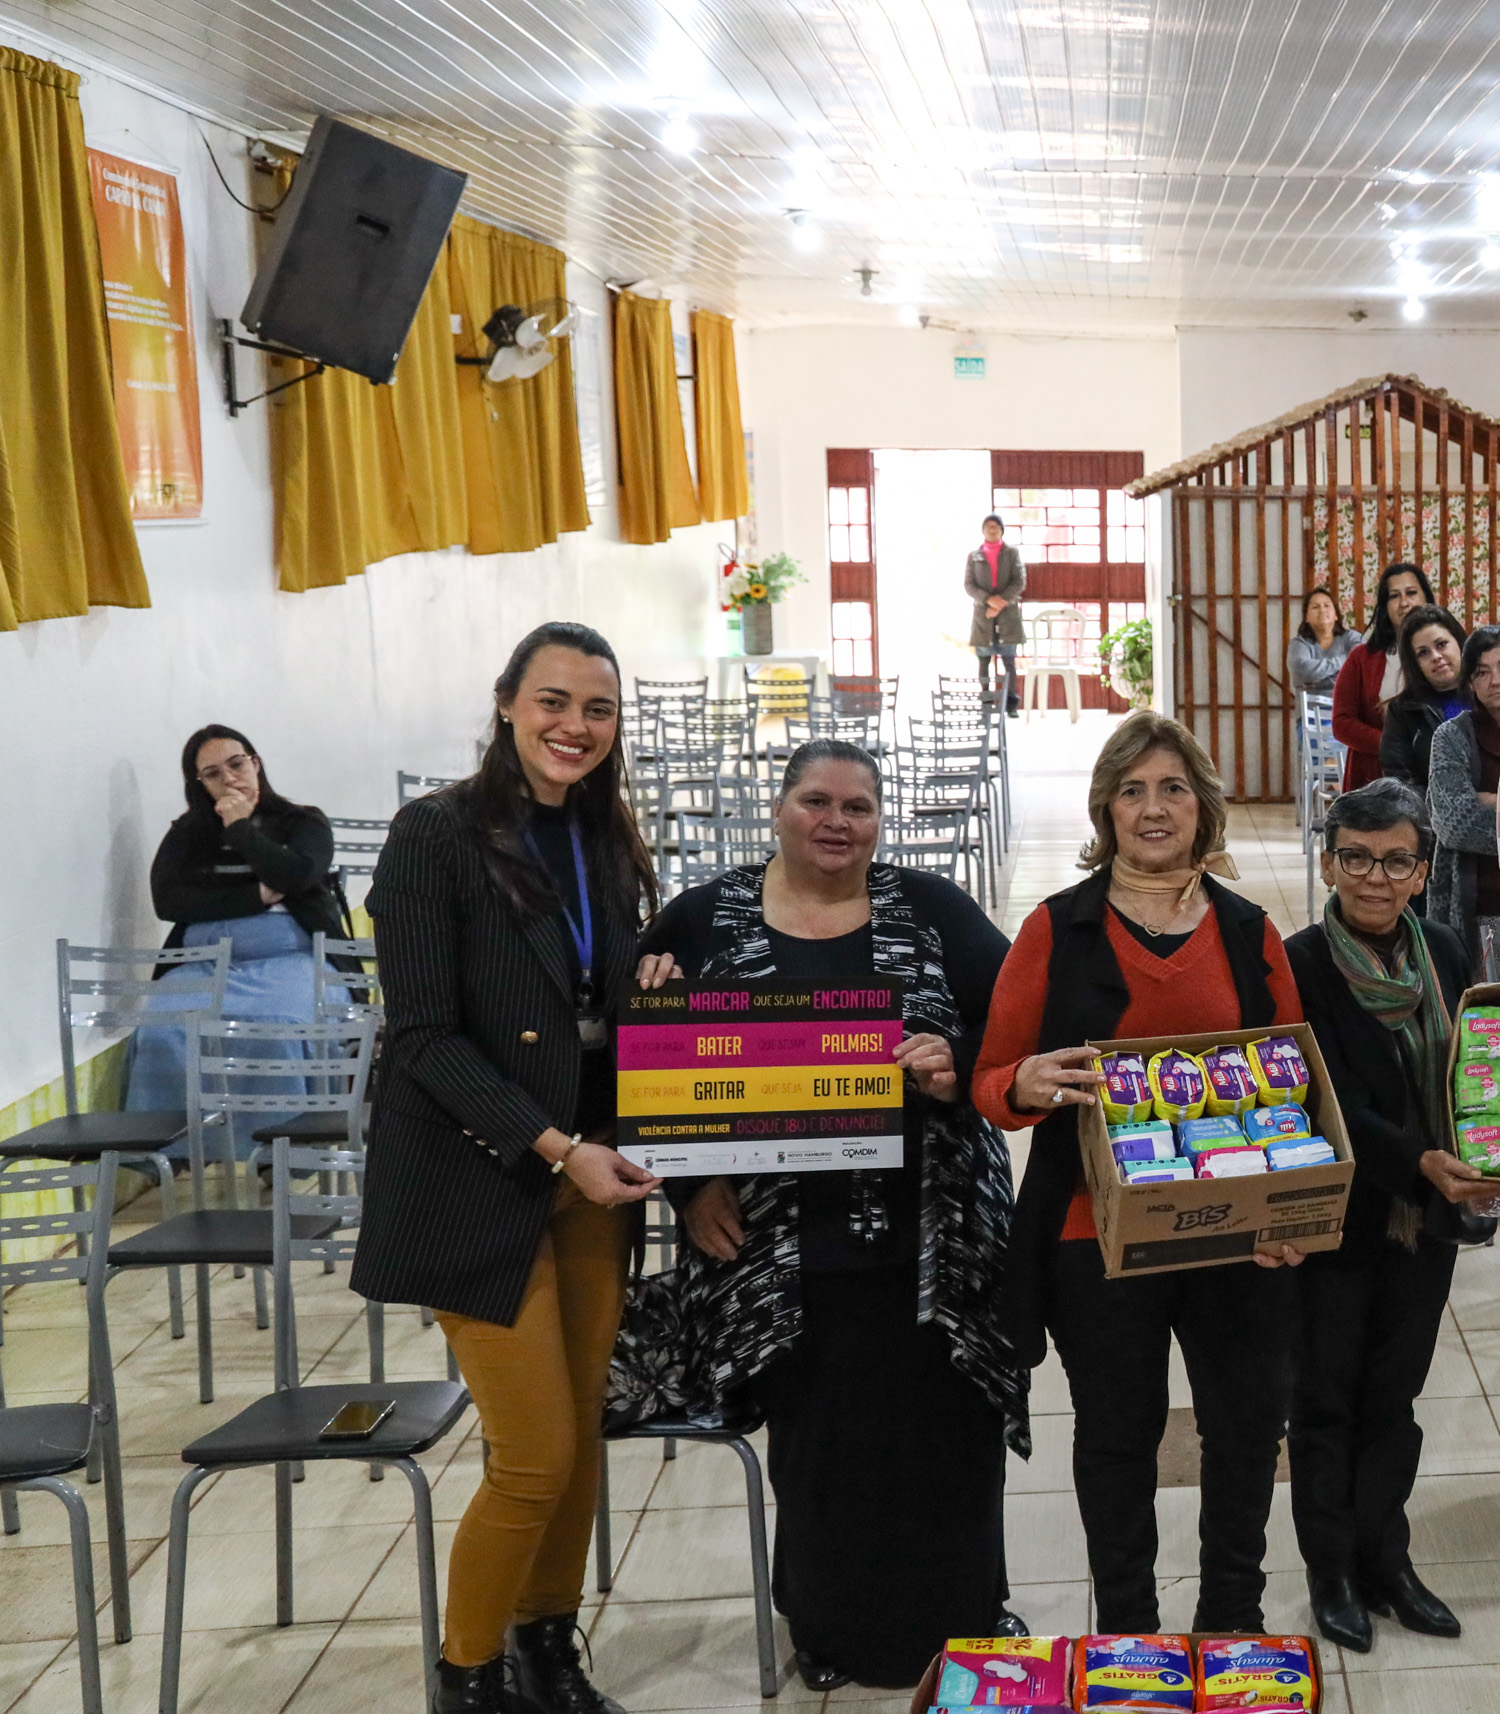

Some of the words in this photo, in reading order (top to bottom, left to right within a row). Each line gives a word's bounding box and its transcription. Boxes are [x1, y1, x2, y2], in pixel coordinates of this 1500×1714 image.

[630, 996, 641, 1009] SE
[643, 996, 661, 1009] FOR
[662, 996, 686, 1008] PARA
[689, 991, 750, 1012] MARCAR
[753, 995, 772, 1007] QUE
[773, 995, 795, 1006] SEJA
[796, 995, 810, 1006] UM
[813, 989, 891, 1009] ENCONTRO!
[1472, 1021, 1500, 1031] Ladysoft
[697, 1035, 743, 1056] BATER
[821, 1033, 884, 1053] PALMAS!
[1467, 1065, 1490, 1075] Ladysoft
[643, 1087, 661, 1098] FOR
[663, 1085, 687, 1097] PARA
[694, 1081, 746, 1101] GRITAR
[761, 1084, 779, 1095] QUE
[781, 1082, 802, 1094] SEJA
[813, 1078, 831, 1097] EU
[835, 1078, 851, 1096] TE
[855, 1077, 892, 1096] AMO!
[638, 1125, 671, 1136] VIOLÊNCIA
[672, 1125, 698, 1135] CONTRA
[698, 1125, 704, 1135] A
[704, 1124, 730, 1134] MULHER
[736, 1119, 780, 1135] DISQUE
[785, 1118, 807, 1133] 180
[1470, 1129, 1498, 1143] Ladysoft
[842, 1148, 878, 1158] COMDIM
[1113, 1654, 1169, 1665] always
[1230, 1655, 1286, 1666] always
[1165, 1675, 1177, 1684] 4
[1282, 1675, 1294, 1683] 4
